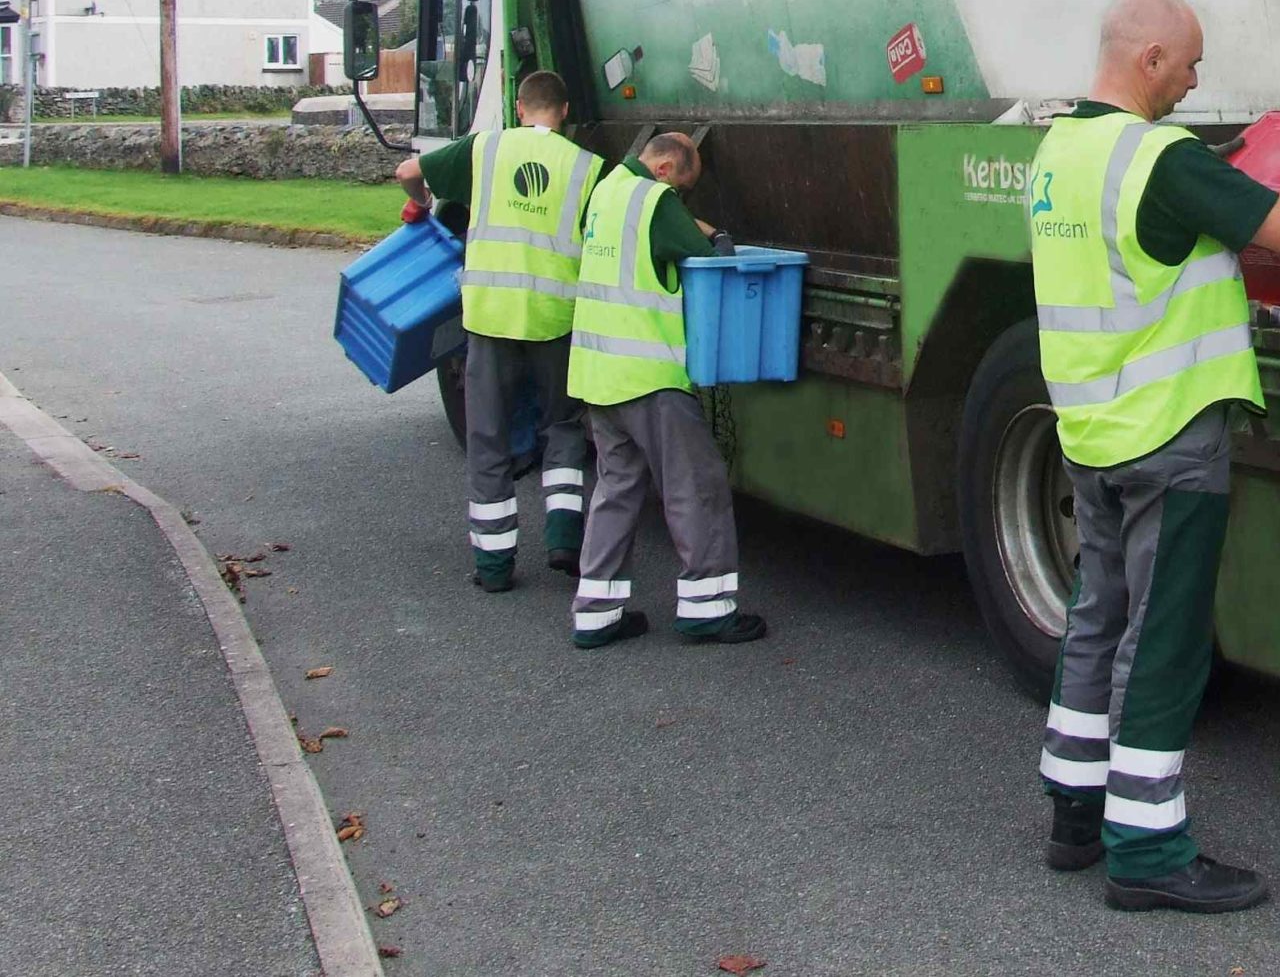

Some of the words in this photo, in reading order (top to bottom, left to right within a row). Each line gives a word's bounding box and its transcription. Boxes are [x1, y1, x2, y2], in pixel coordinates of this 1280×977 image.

[890, 37, 912, 62] Cola
[507, 199, 548, 215] verdant
[745, 282, 760, 300] 5
